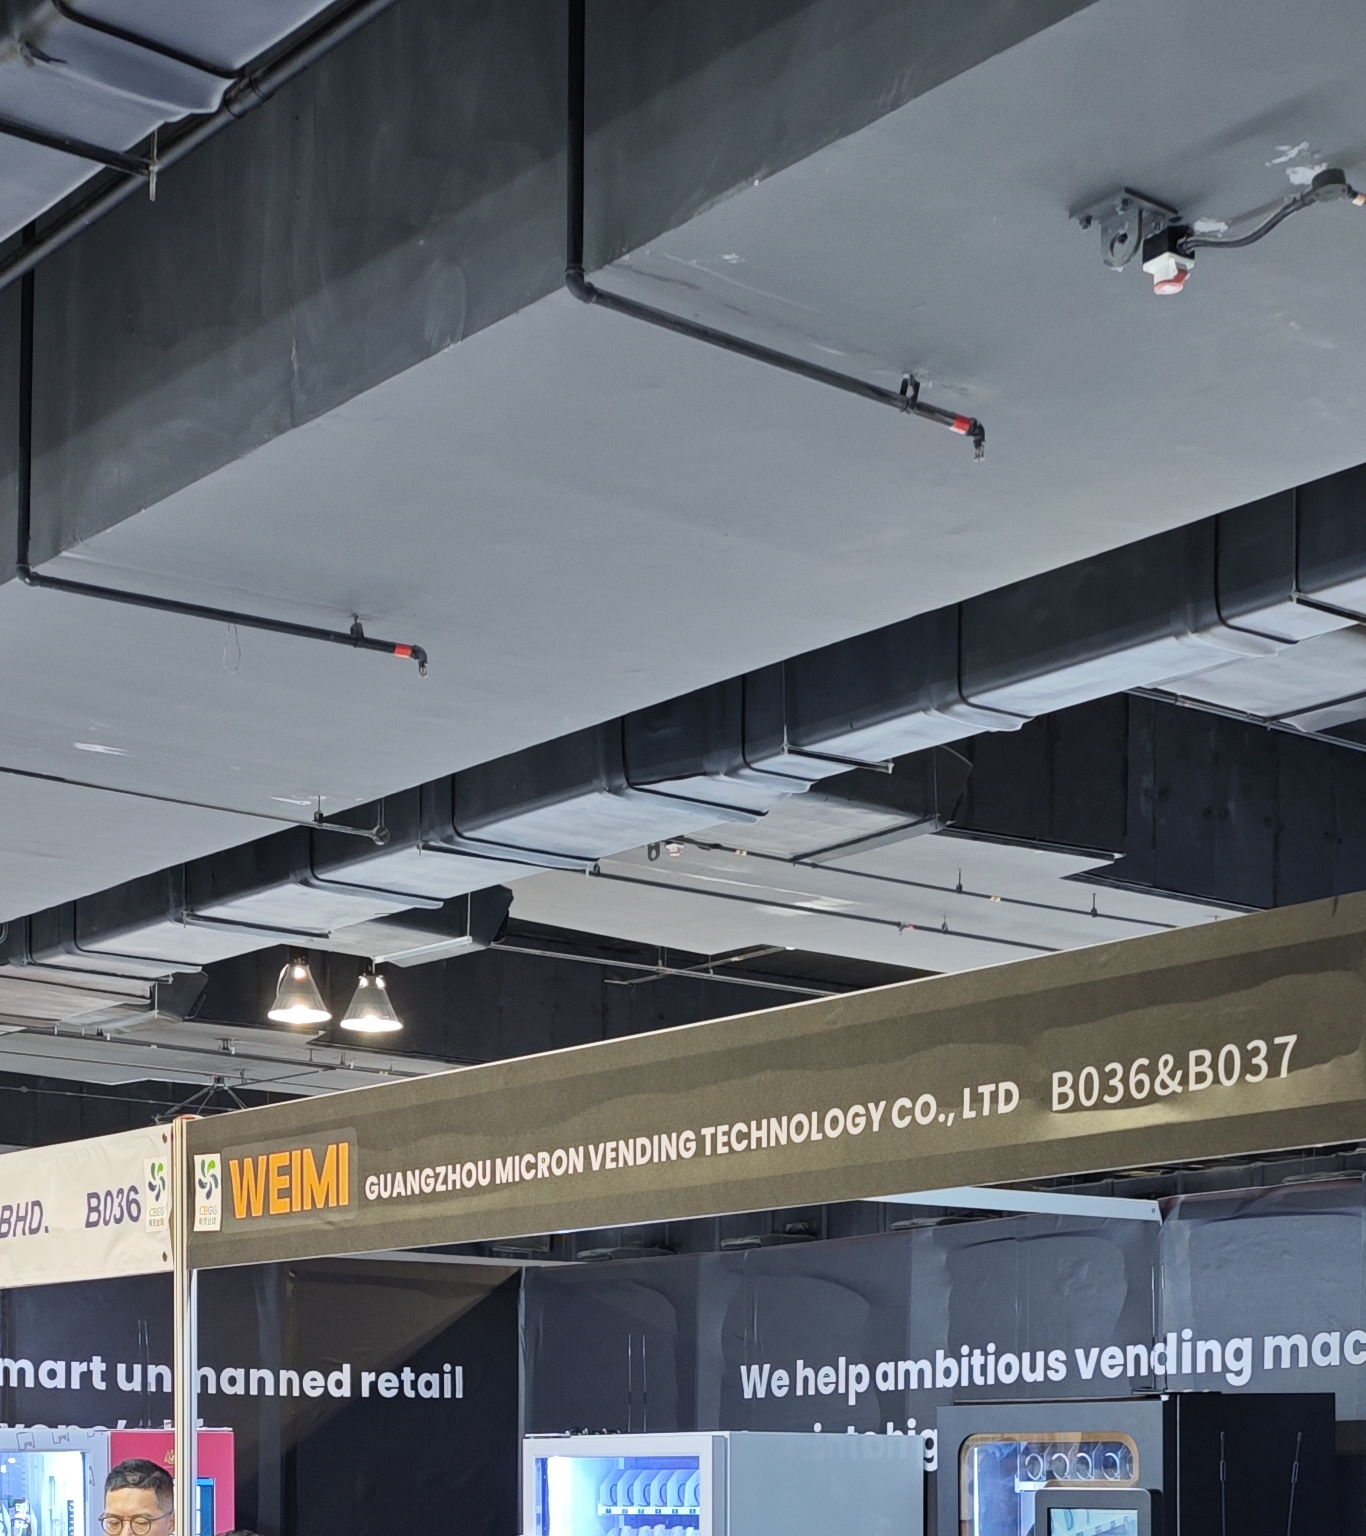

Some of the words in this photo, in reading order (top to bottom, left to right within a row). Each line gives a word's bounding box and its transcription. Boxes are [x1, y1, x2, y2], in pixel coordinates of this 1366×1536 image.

[1051, 1034, 1299, 1112] B036&B037
[228, 1140, 351, 1220] WEIMI
[364, 1158, 491, 1202] GUANGZHOU
[494, 1147, 585, 1185] MICRON
[587, 1130, 697, 1172] VENDING
[700, 1100, 887, 1157] TECHNOLOGY
[961, 1081, 1021, 1120] LTD
[84, 1183, 142, 1229] B036
[361, 1365, 464, 1400] retail
[739, 1362, 790, 1399] We
[794, 1356, 870, 1406] help
[874, 1342, 1068, 1393] ambitious
[1073, 1328, 1254, 1387] vending
